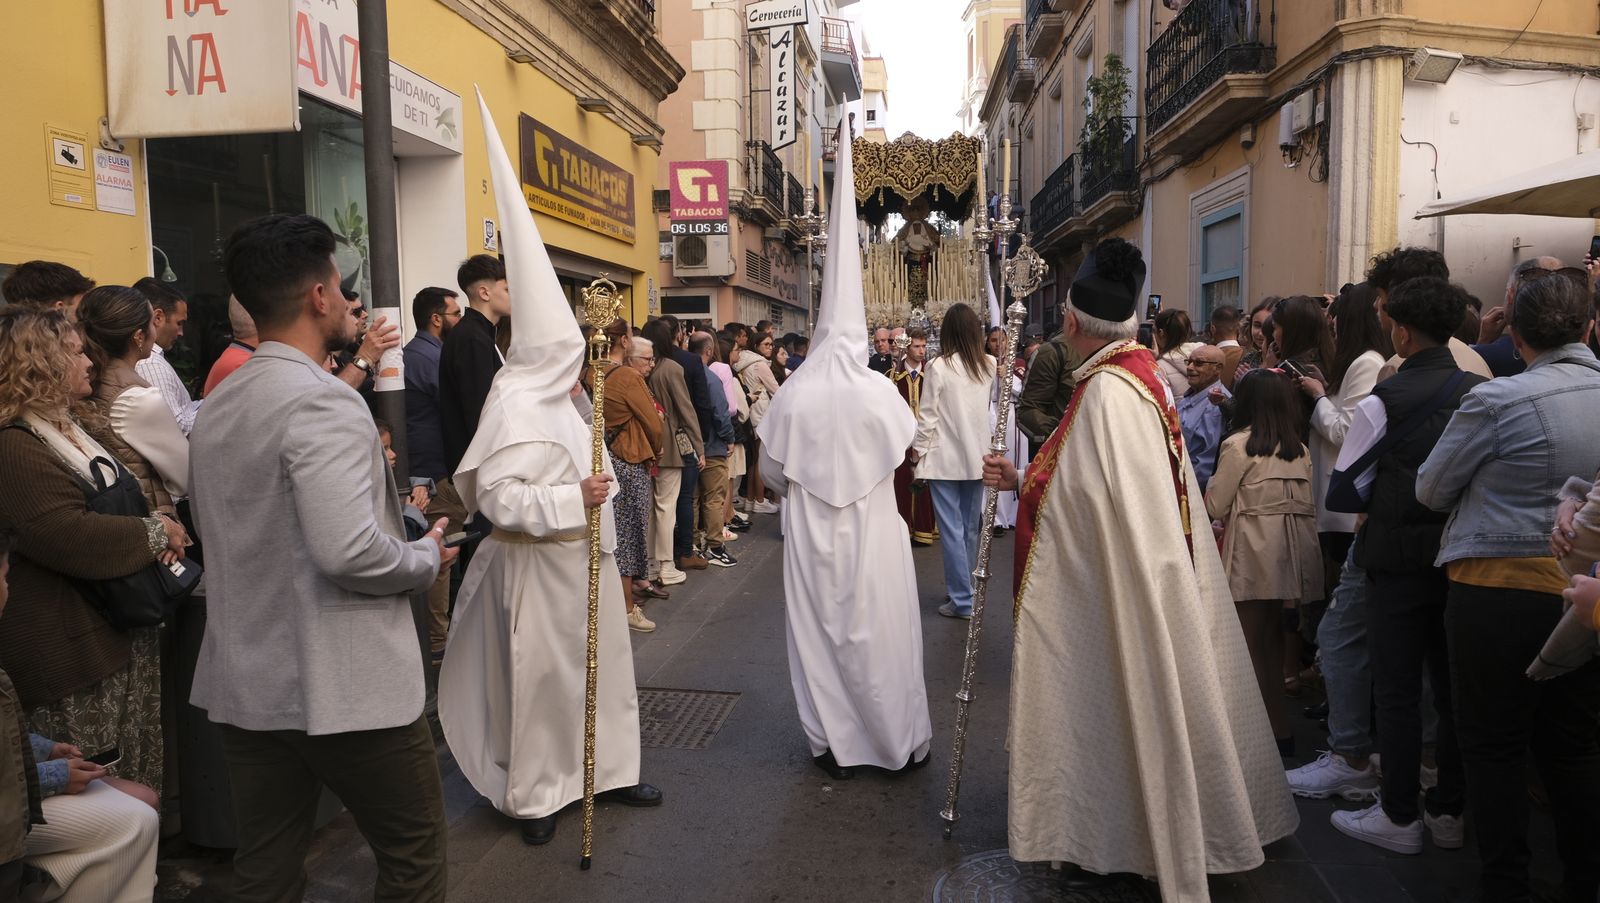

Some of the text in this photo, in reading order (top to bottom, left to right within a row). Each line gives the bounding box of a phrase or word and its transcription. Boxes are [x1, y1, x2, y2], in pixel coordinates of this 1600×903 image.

[749, 5, 802, 22] Cervecería
[389, 73, 441, 111] CUIDAMOS
[771, 30, 792, 141] Alcazar
[403, 104, 428, 127] DE TI
[108, 155, 129, 167] EULEN
[96, 173, 132, 188] ALARMA
[560, 147, 627, 207] TABACOS
[482, 179, 488, 194] 5
[557, 203, 564, 213] DE
[674, 208, 723, 216] TABACOS
[671, 222, 728, 233] OS LOS 36
